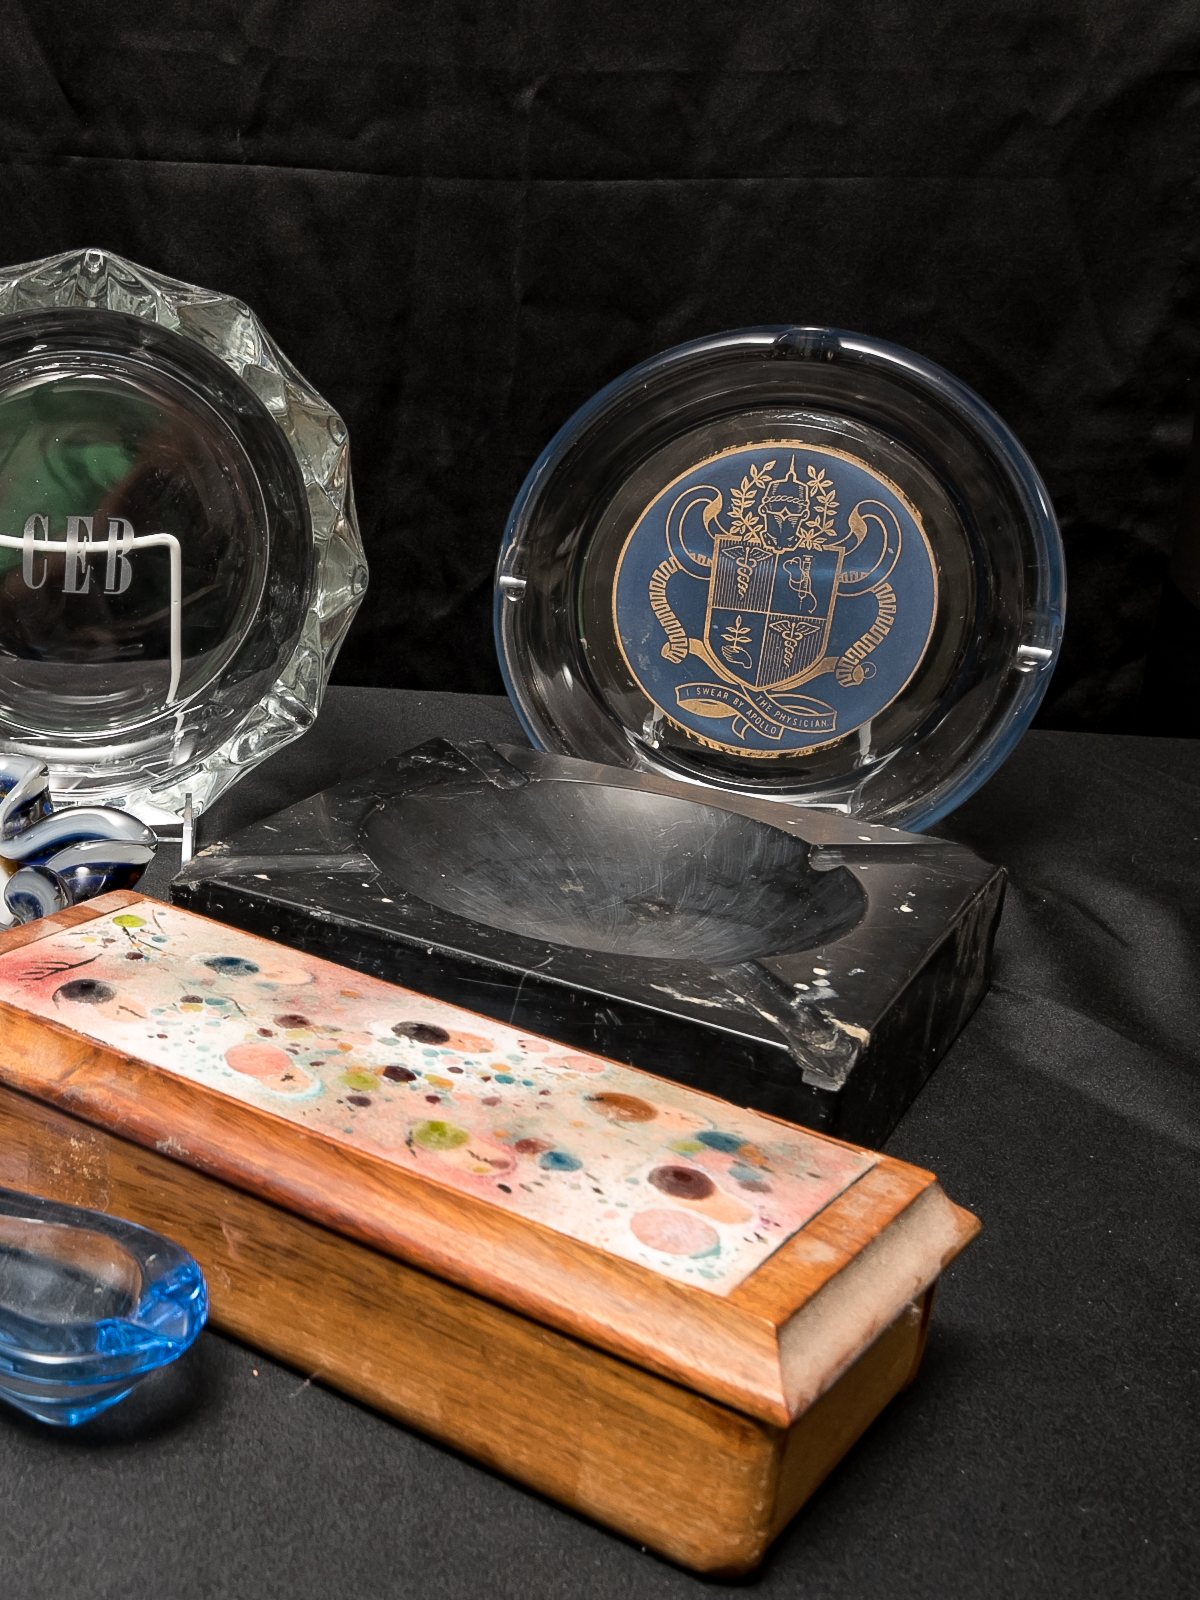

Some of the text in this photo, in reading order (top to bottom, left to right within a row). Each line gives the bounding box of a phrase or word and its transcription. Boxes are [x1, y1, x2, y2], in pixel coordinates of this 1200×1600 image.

[22, 512, 135, 595] CEB
[685, 687, 777, 735] I SWEAR BY APOLLO
[755, 694, 773, 713] THE
